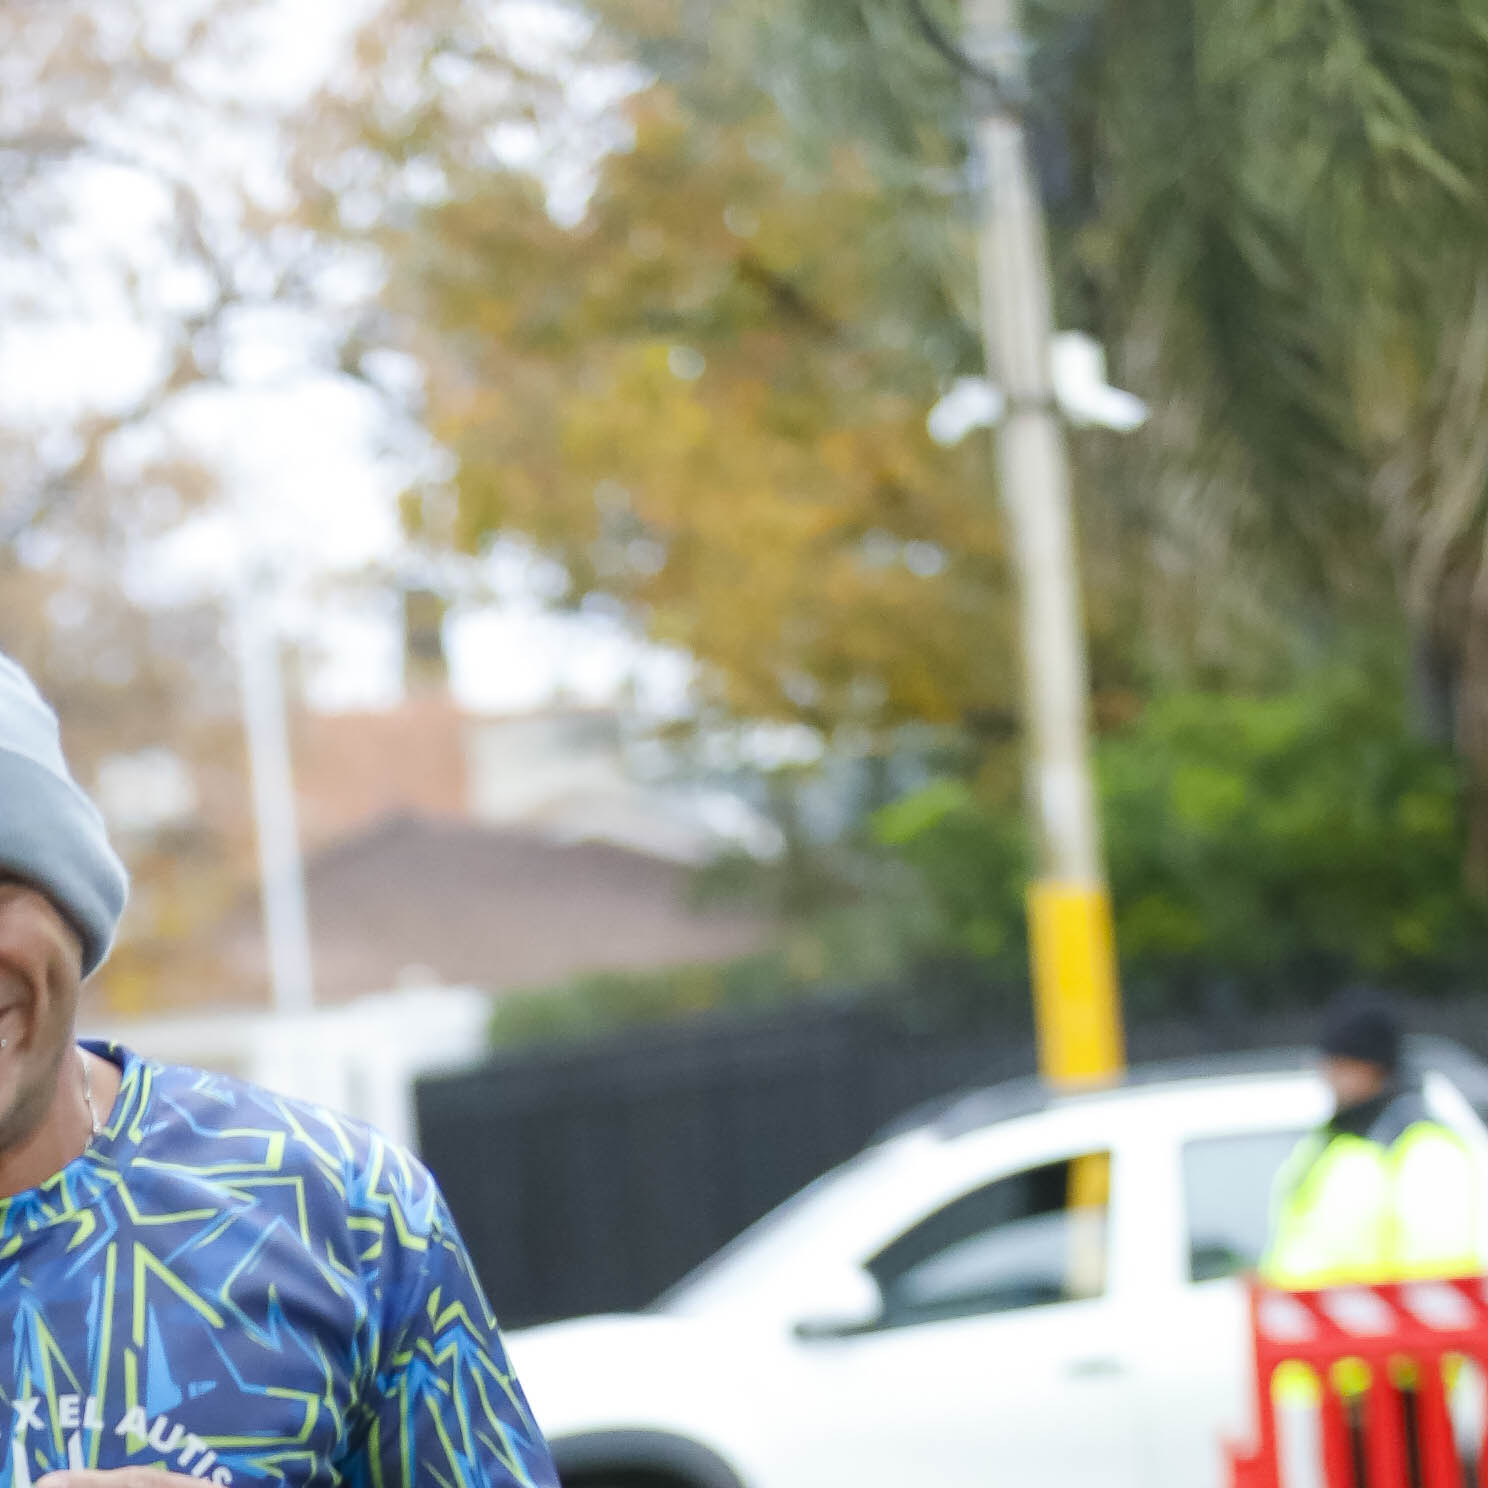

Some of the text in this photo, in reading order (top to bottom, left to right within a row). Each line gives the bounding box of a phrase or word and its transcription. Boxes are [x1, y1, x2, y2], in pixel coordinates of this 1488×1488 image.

[12, 1397, 45, 1433] X
[59, 1393, 105, 1430] EL
[115, 1405, 233, 1487] AUTIS
